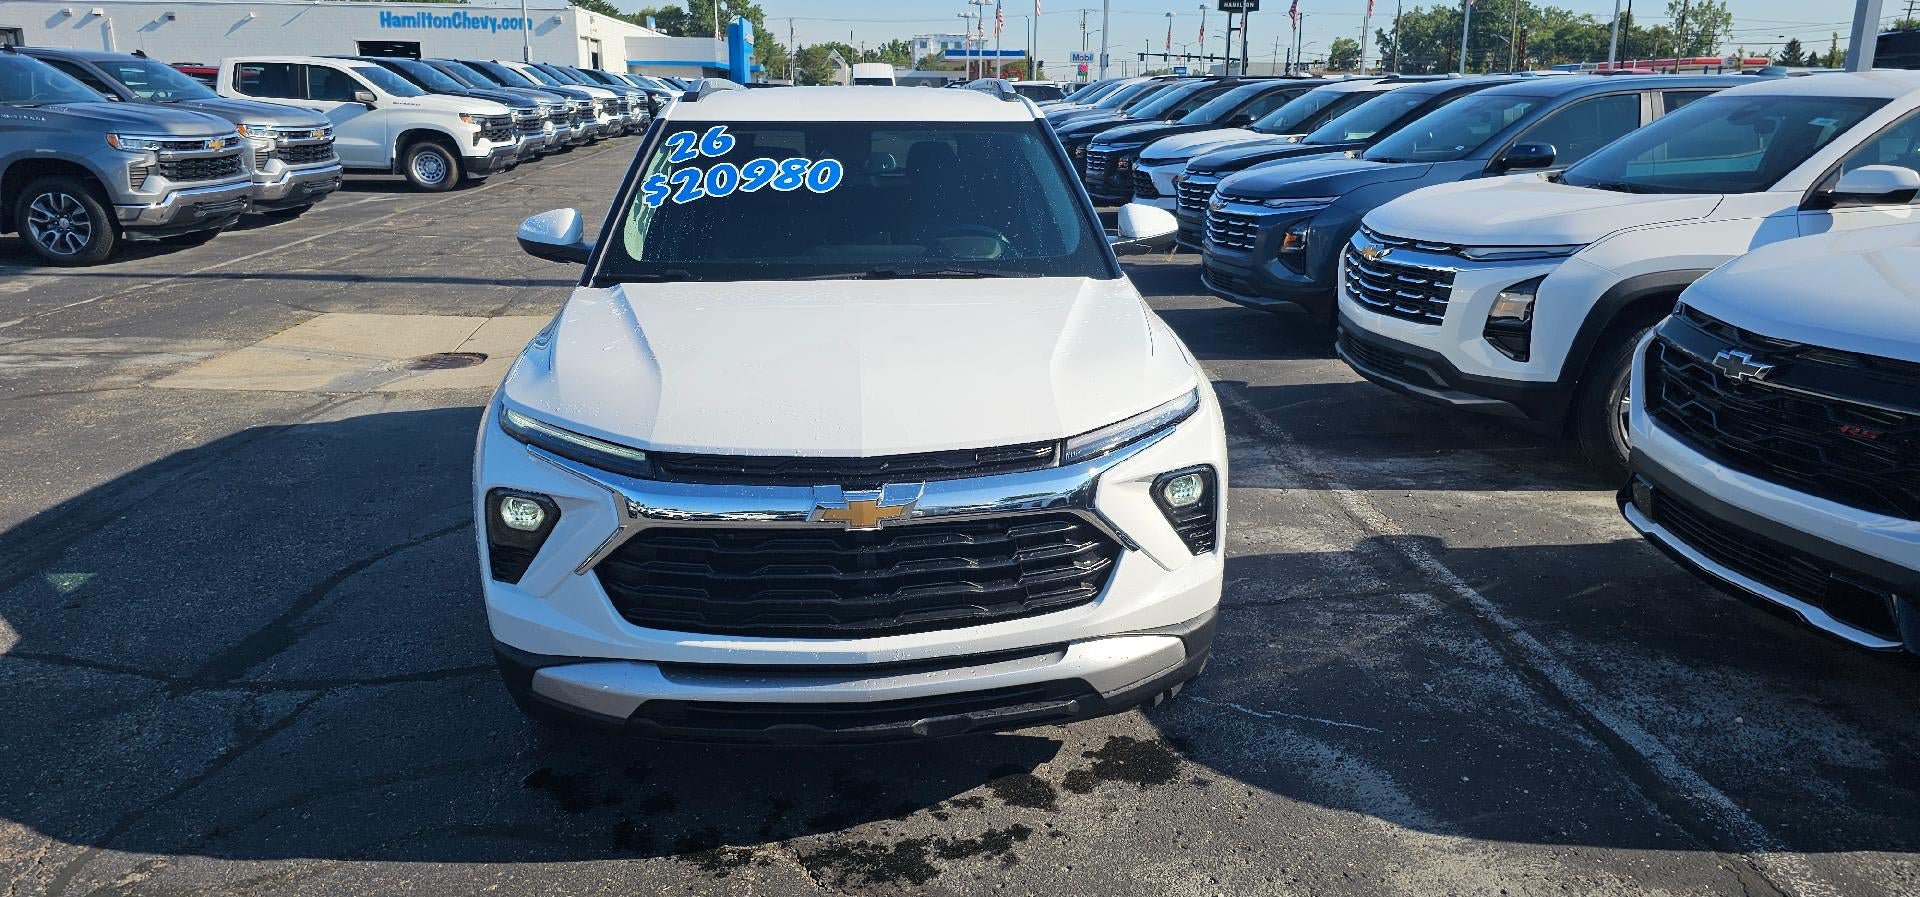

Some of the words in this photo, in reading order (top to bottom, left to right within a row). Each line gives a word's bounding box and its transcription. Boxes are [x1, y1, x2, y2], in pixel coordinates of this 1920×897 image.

[379, 11, 533, 33] HamiltonChevy.com
[1072, 53, 1094, 61] Mobil
[665, 125, 736, 163] 26
[641, 157, 843, 208] $20980
[1841, 425, 1877, 440] RS
